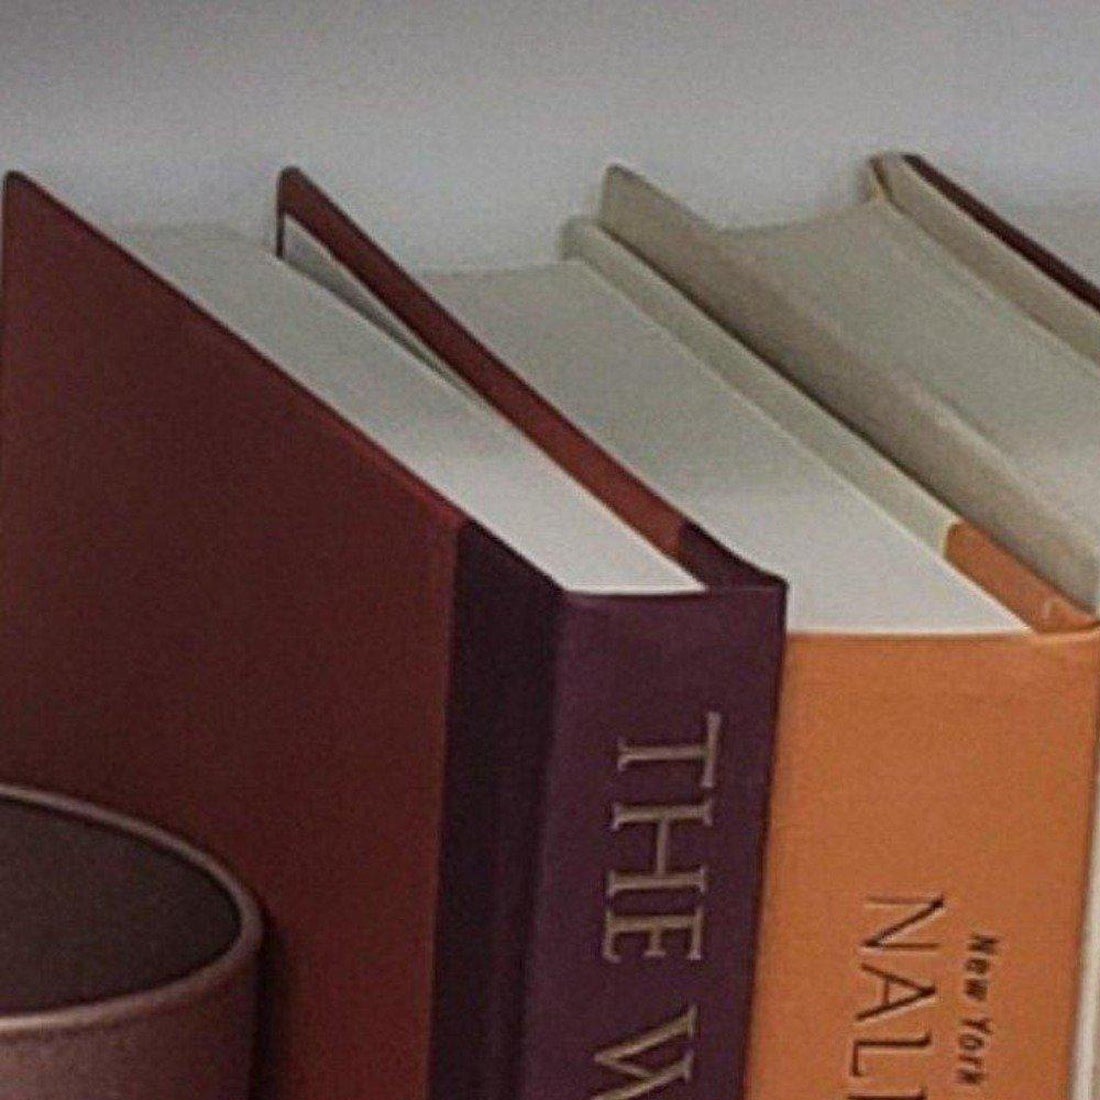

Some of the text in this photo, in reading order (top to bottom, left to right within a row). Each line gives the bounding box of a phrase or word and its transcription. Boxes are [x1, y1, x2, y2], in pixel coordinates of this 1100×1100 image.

[603, 711, 722, 964] THE
[965, 932, 999, 1000] New
[957, 1016, 994, 1086] York
